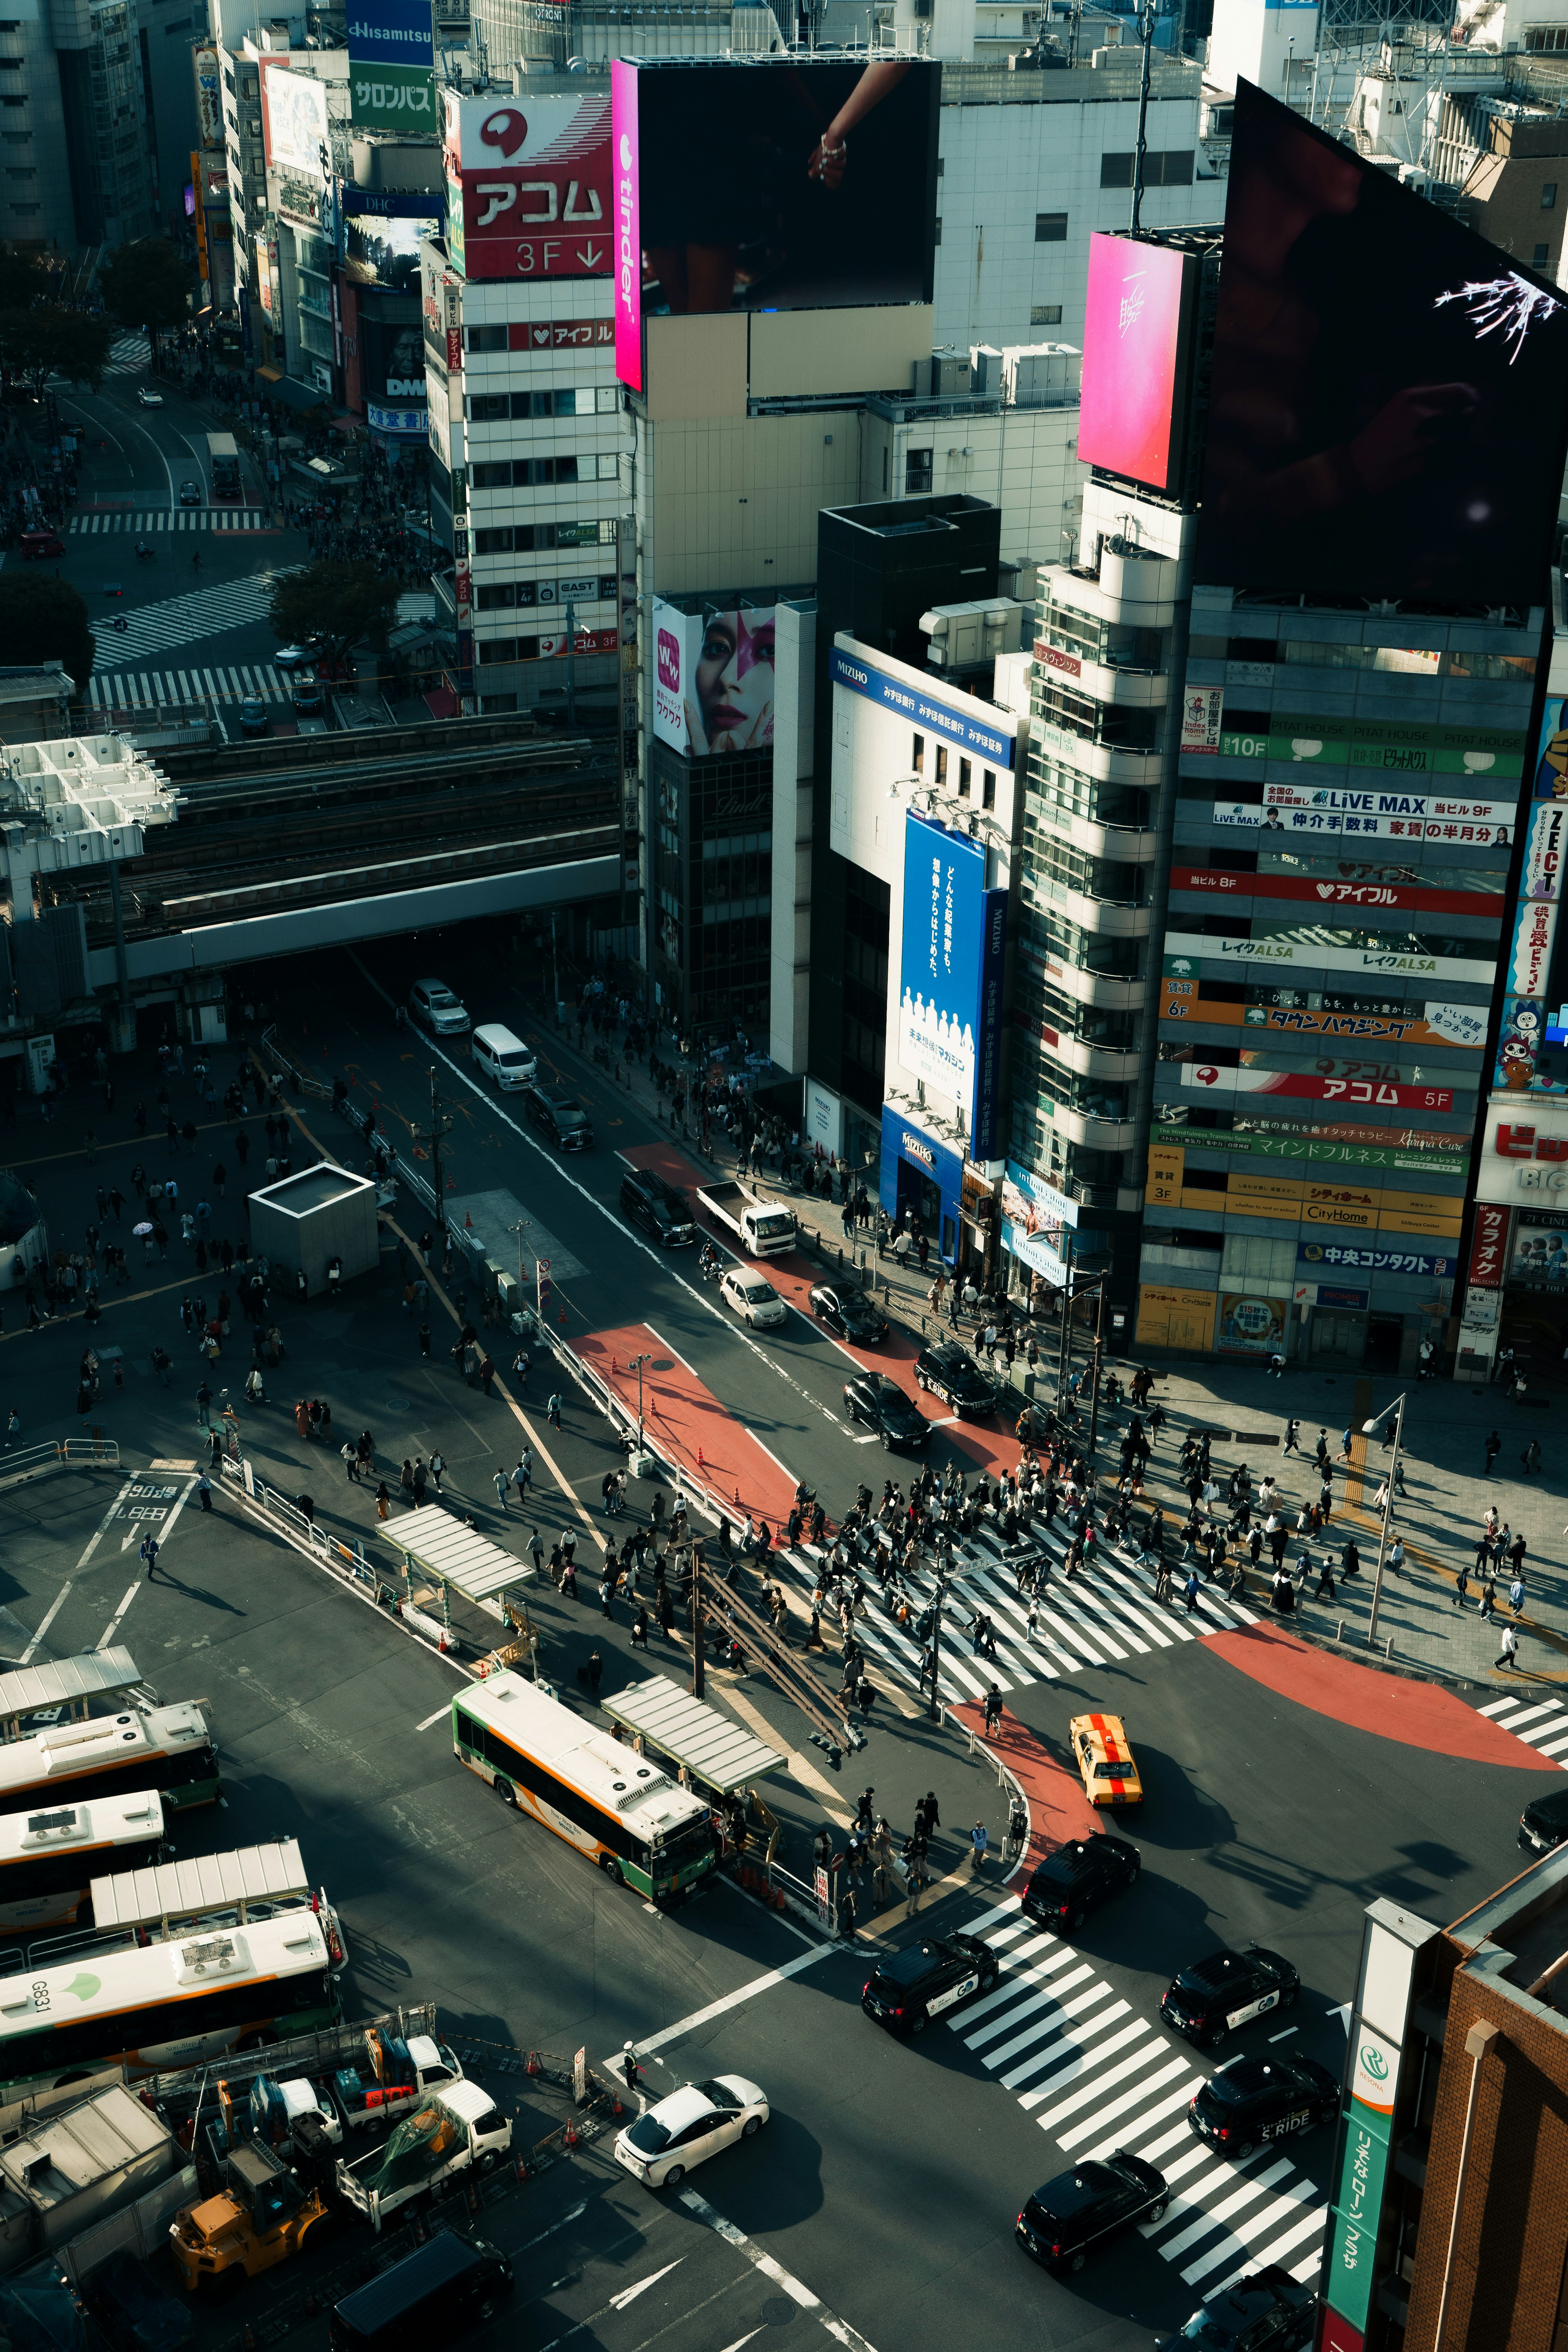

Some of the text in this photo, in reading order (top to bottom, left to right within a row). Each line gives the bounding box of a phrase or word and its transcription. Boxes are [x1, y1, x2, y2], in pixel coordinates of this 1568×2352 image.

[536, 9, 561, 21] QFRONT
[349, 22, 431, 43] Hisamitsu
[356, 83, 430, 112] サロンパス
[366, 197, 395, 212] DHC
[449, 192, 463, 225] レイク
[476, 180, 603, 226] アコム
[620, 178, 634, 313] tinder
[517, 241, 563, 272] 3F
[555, 326, 612, 344] アイフル
[450, 338, 459, 369] アイフル
[558, 528, 596, 538] レイクALSA
[521, 592, 532, 603] 4F
[603, 637, 616, 646] 3F
[837, 659, 868, 684] MIZUHO
[1042, 650, 1079, 674] スヴェンソン
[656, 688, 682, 711] 劇的マッチング
[657, 699, 681, 729] ワクワク
[884, 686, 1003, 755] みずほ銀行 みずほ信託銀行 みずほ証券
[1206, 691, 1221, 746] お部屋探しは
[1272, 721, 1346, 735] PITAT HOUSE
[1354, 727, 1429, 742] PITAT HOUSE
[1231, 737, 1266, 757] 10F
[1444, 733, 1521, 748] PITAT HOUSE
[1353, 748, 1427, 770] 賃貸・売買 ピタットハウス
[625, 769, 636, 779] 3F
[1267, 786, 1294, 796] 全国の
[1267, 795, 1310, 806] お部屋探し
[711, 793, 767, 817] Lindt
[1330, 791, 1427, 815] LiVE MAX
[1434, 803, 1492, 816] 当ビル 9F
[910, 807, 924, 820] MIZUHO
[1032, 802, 1071, 826] YAG BEAUTY CLINIC
[1214, 815, 1260, 826] LiVE MAX
[1292, 812, 1492, 842] 仲介手数料 家賃の半月分
[1532, 810, 1548, 881] 分かりやすいって素晴らしい。
[1543, 810, 1563, 893] ZECT
[1190, 876, 1398, 904] 当ビル 8F アイフル
[929, 857, 941, 978] 想像からはじめた。
[943, 865, 955, 975] どんな起業家も、
[991, 908, 1003, 955] MIZUHO
[1222, 941, 1294, 958] レイクALSA
[1442, 940, 1464, 956] 7F
[1363, 954, 1437, 971] レイクALSA
[1167, 982, 1192, 996] 賃貸
[1168, 1001, 1189, 1017] 6F
[1443, 1005, 1483, 1033] いい部屋
[1030, 1024, 1042, 1037] NAIL
[1031, 1018, 1042, 1028] FAST
[1270, 1009, 1414, 1040] タウンハウジング
[1430, 1012, 1479, 1044] 見つかる！
[40, 1049, 49, 1071] 渋谷駅
[938, 1045, 965, 1072] マガジン
[981, 980, 997, 1147] みずほ証券 みずほ信託銀行 みずほ銀行
[1341, 1060, 1401, 1082] アコム
[1323, 1079, 1449, 1107] アコム 5F
[815, 1096, 831, 1112] MIZUHO
[1171, 1129, 1208, 1138] Mindfulness
[1209, 1133, 1233, 1141] Training
[1241, 1118, 1393, 1140] 心と脳の疲れを癒すタッチセラピー
[902, 1132, 933, 1163] MIZUHO
[1259, 1139, 1387, 1164] マインドフルネス
[1439, 1137, 1464, 1152] Cure
[1154, 1170, 1175, 1181] 賃貸
[1018, 1171, 1066, 1208] intimissimi
[1155, 1187, 1171, 1199] 3F
[1310, 1187, 1372, 1204] シティホーム
[1307, 1205, 1368, 1223] CityHome
[1410, 1201, 1438, 1209] 渋谷センター
[1526, 1214, 1538, 1223] 7F
[1477, 1211, 1503, 1276] カラオケ
[1015, 1238, 1060, 1275] intimissimi
[1325, 1247, 1446, 1276] 中央コンタクト 2F
[1144, 1293, 1177, 1303] シティホーム
[1324, 1291, 1361, 1302] PROMISE
[1545, 1285, 1565, 1293] TOEI
[1182, 1297, 1212, 1307] CityHome
[1244, 1305, 1269, 1314] 15秒で
[1237, 1313, 1267, 1323] 事前審査
[573, 1824, 582, 1835] Bus
[32, 1981, 52, 2013] G831
[957, 1980, 974, 1997] GO
[1258, 1996, 1275, 2012] GO
[1359, 2070, 1384, 2094] RESONA
[1261, 2112, 1310, 2142] S.RIDE
[1262, 2116, 1290, 2131] タクシーアプリ
